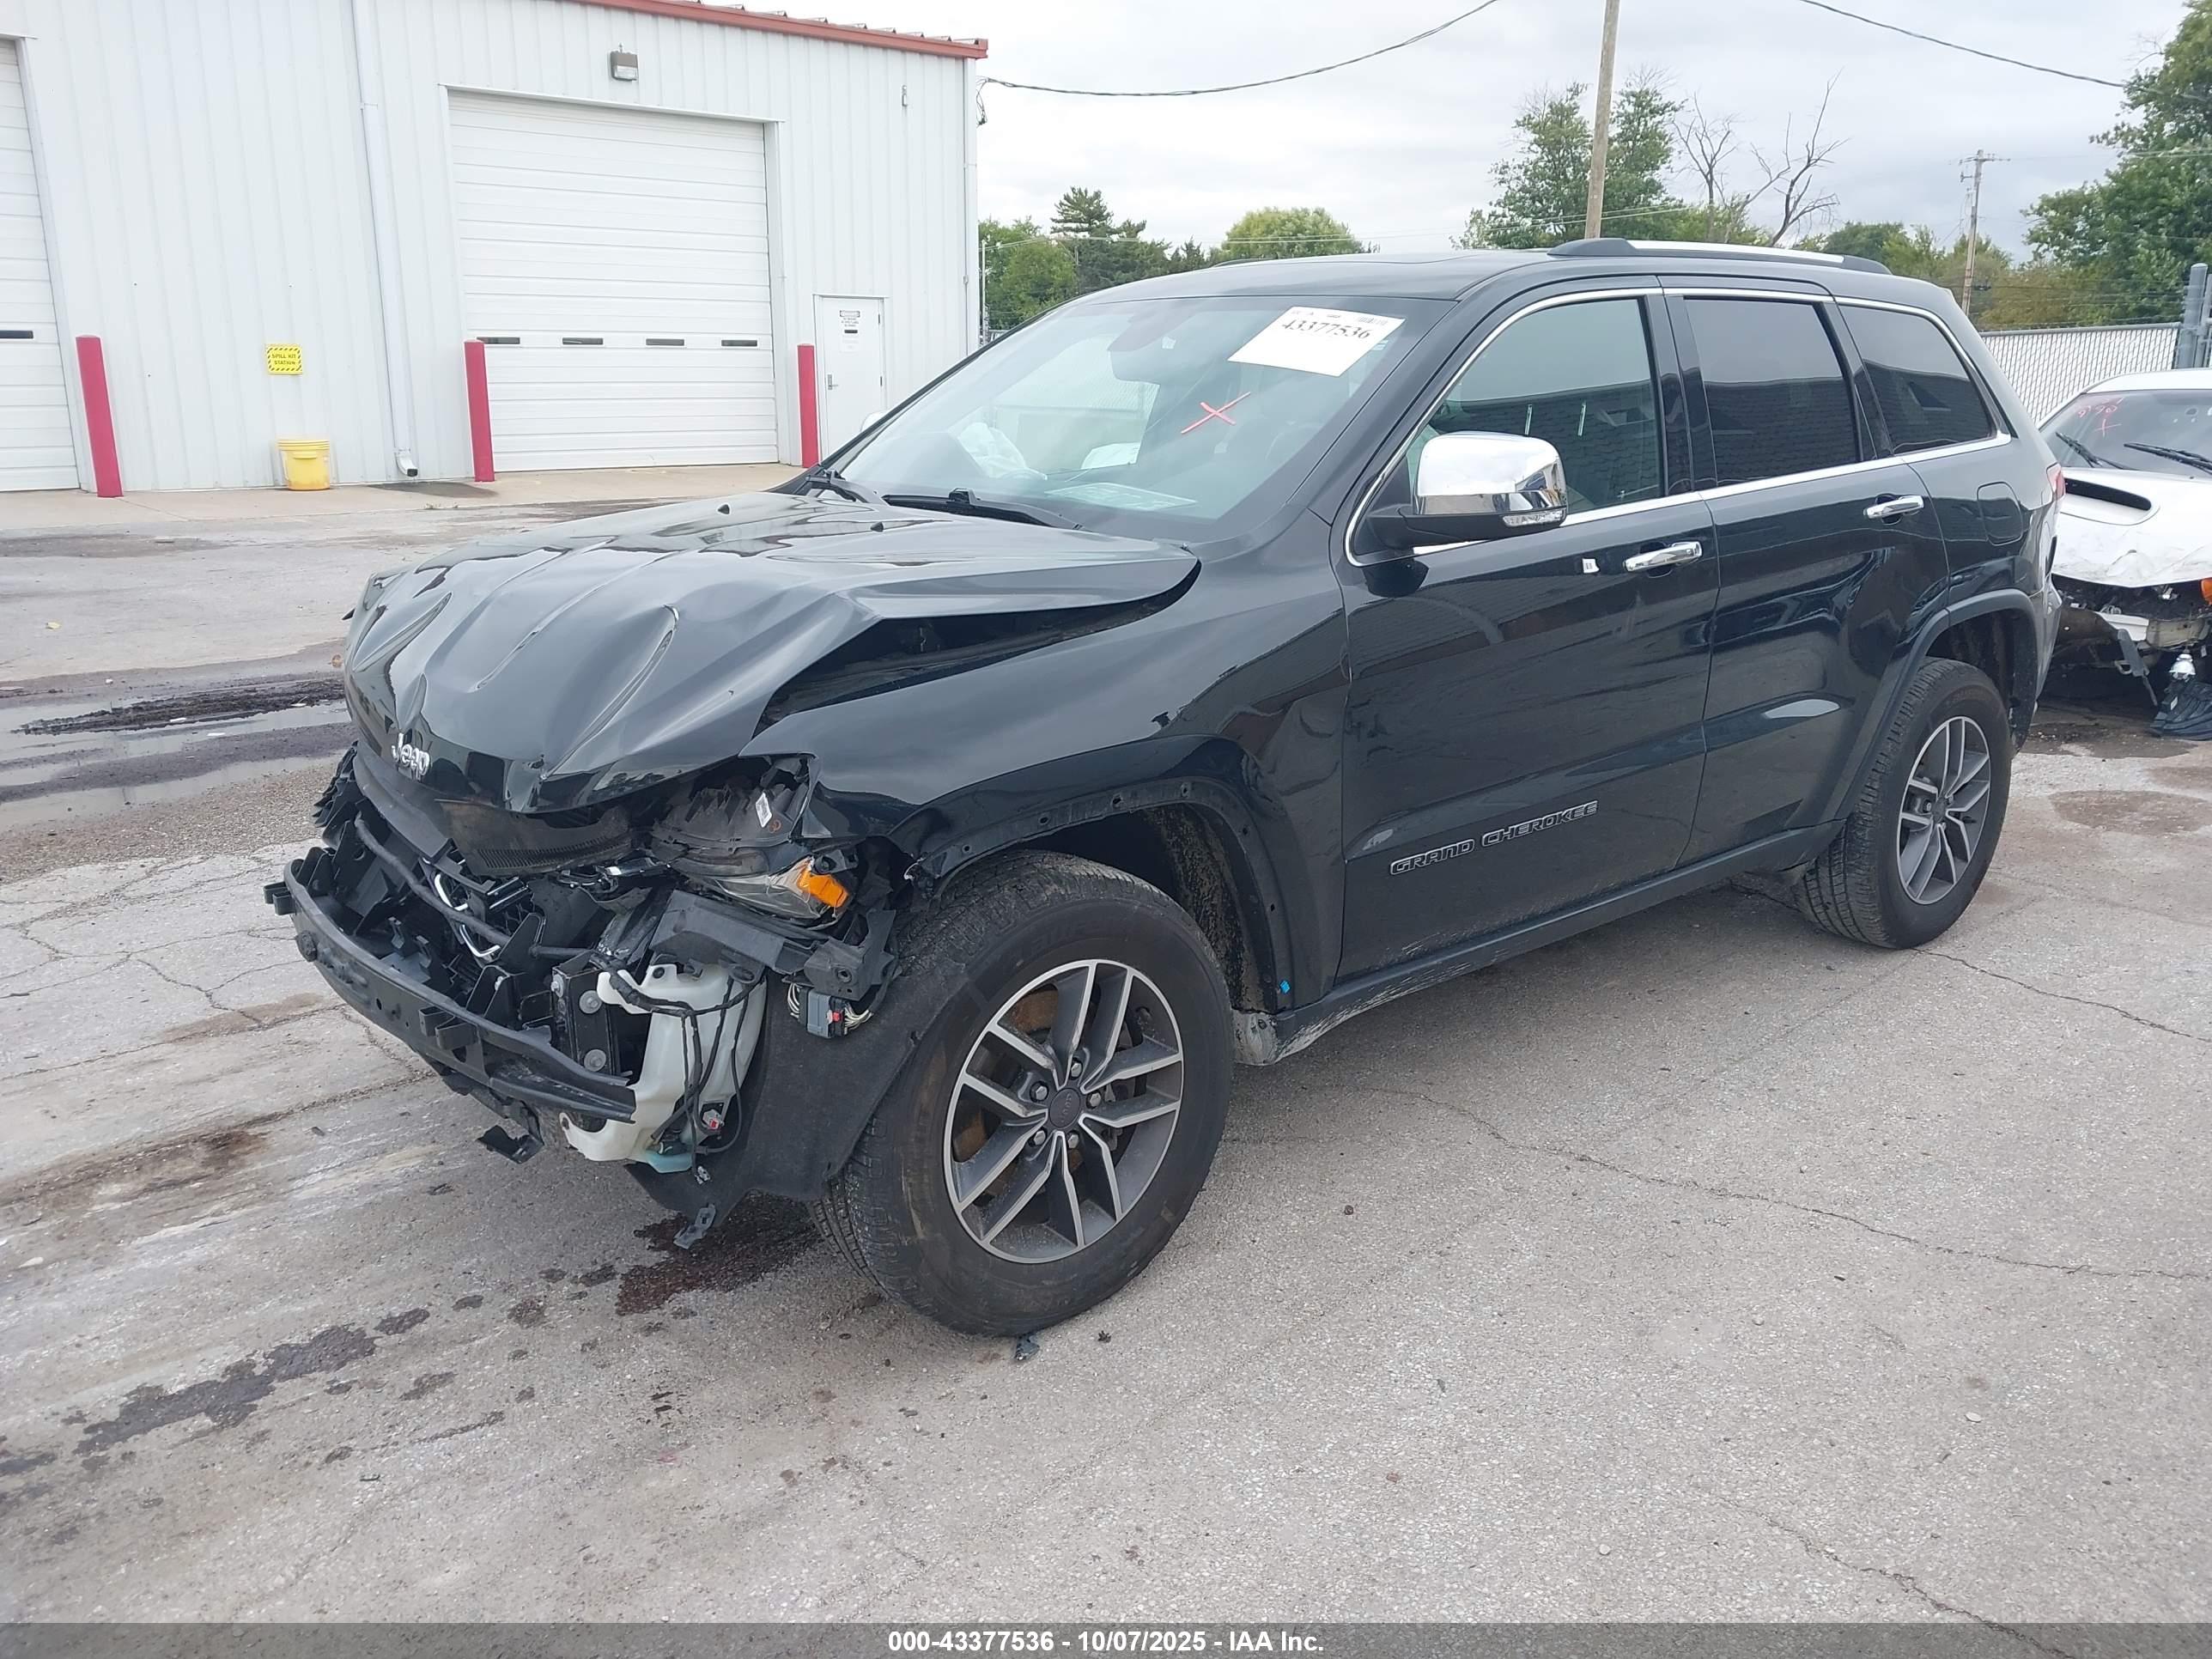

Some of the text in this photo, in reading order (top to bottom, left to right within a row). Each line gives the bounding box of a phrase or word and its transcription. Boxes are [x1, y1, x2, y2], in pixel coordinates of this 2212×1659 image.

[1282, 319, 1373, 338] 43377536
[392, 732, 430, 780] Jeep
[1390, 800, 1599, 875] GRAND CHEROKEE
